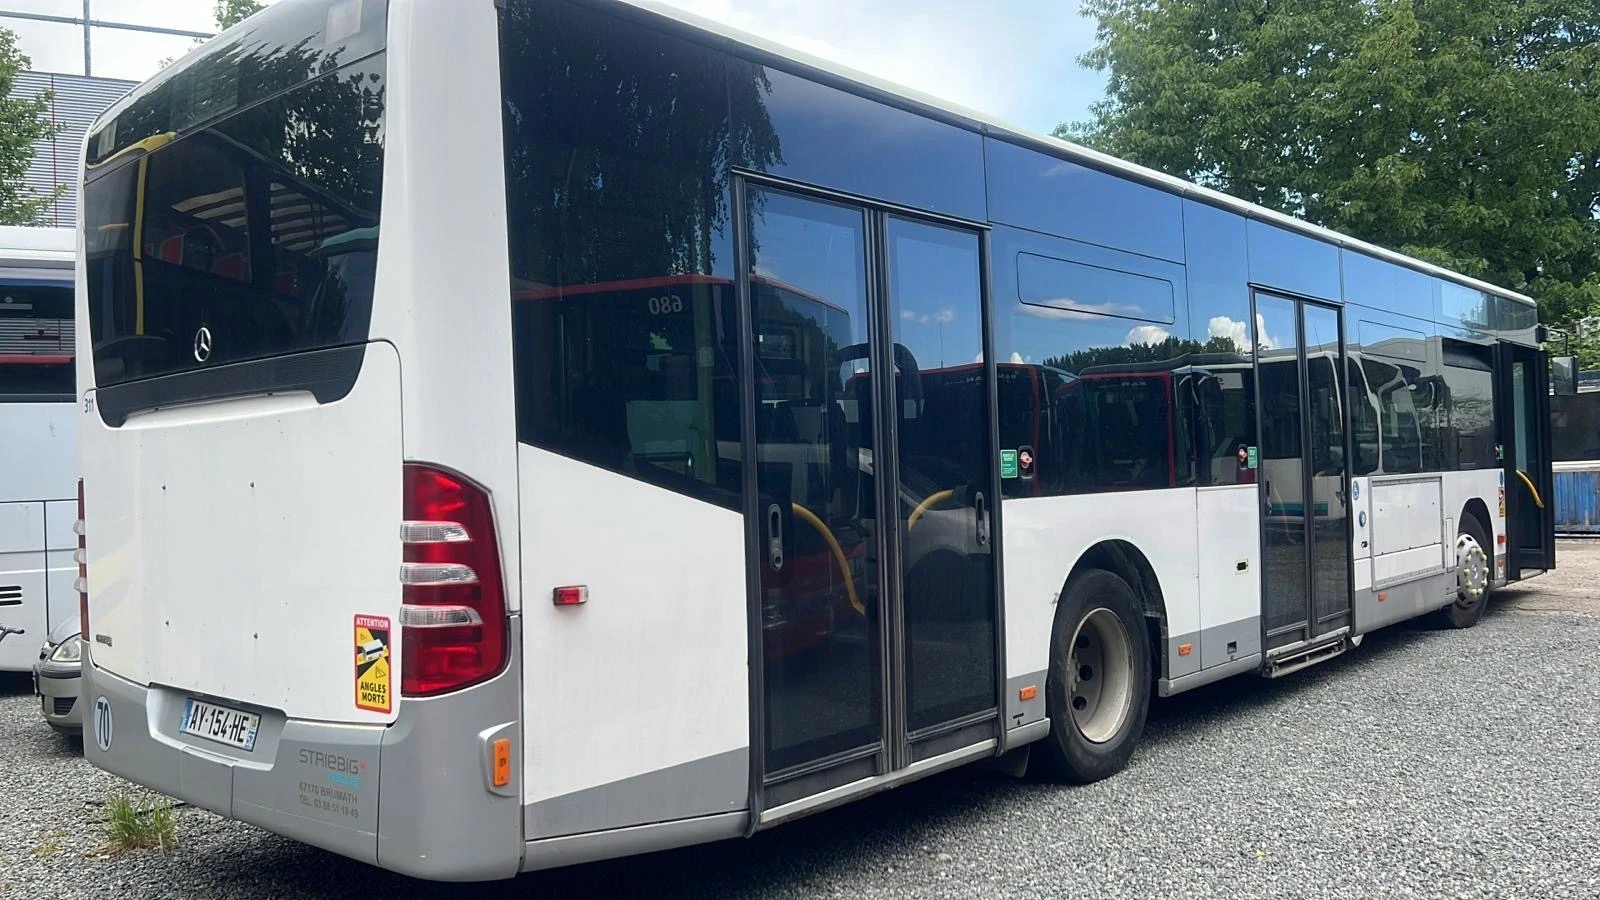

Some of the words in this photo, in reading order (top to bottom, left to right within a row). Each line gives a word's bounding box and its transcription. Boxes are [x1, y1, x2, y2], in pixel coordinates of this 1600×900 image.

[84, 398, 94, 413] 311
[356, 617, 389, 629] ATTENTION
[360, 681, 387, 694] ANGLES
[361, 691, 385, 704] MORTS
[97, 702, 110, 747] 70
[189, 704, 250, 743] AY-154-HE
[320, 786, 358, 804] BRUMATH
